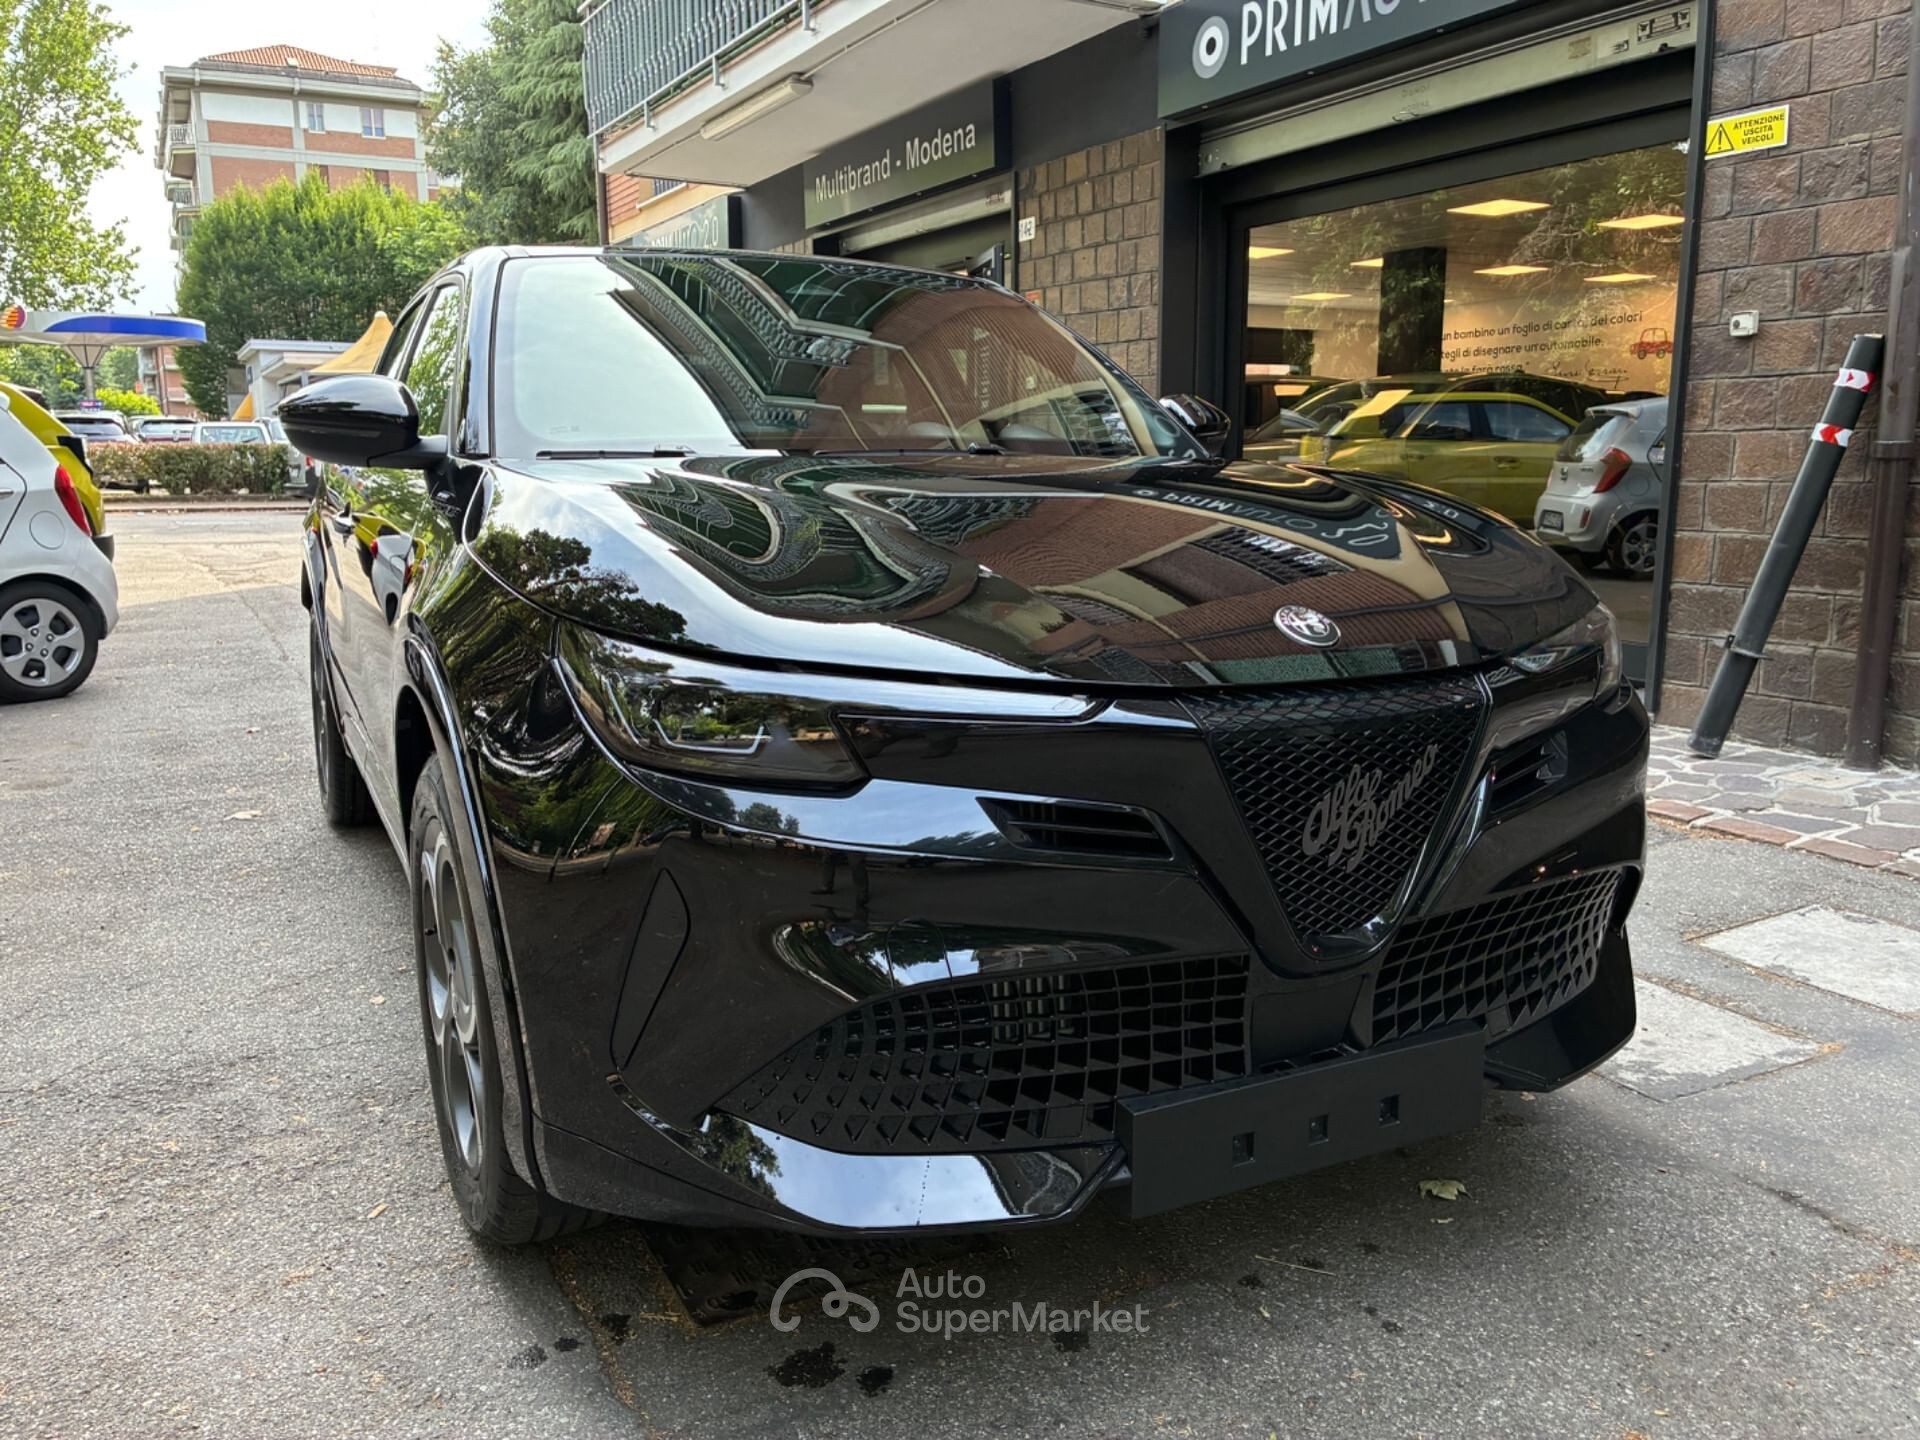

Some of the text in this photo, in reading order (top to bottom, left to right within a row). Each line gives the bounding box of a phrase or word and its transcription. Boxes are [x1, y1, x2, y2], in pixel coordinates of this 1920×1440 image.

[1733, 113, 1785, 130] ATTENZIONE
[1743, 124, 1773, 137] USCITA
[1742, 133, 1774, 145] VEICOLI
[815, 149, 891, 203] Multibrand
[906, 123, 976, 170] Modena
[1454, 328, 1496, 340] bambino
[1497, 327, 1511, 336] un
[1512, 321, 1540, 337] foglio
[1542, 320, 1553, 331] di
[1610, 310, 1643, 325] colori
[1473, 343, 1522, 359] disegnare
